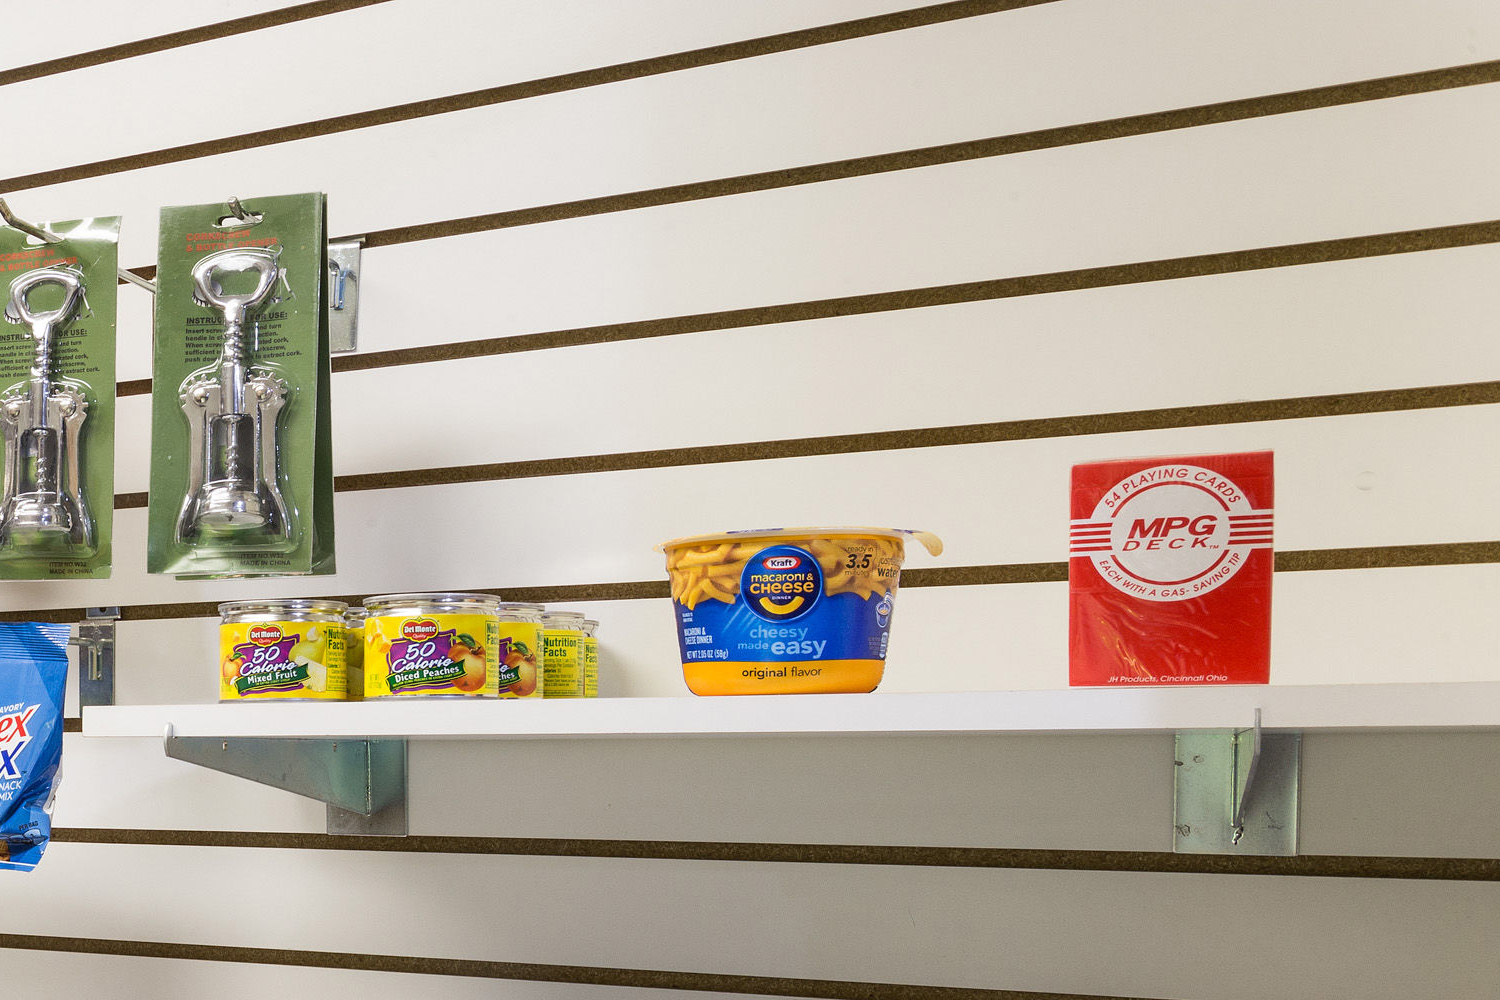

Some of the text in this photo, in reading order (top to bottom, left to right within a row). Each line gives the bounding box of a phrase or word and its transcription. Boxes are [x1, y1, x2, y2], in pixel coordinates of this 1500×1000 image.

[186, 229, 251, 242] CORKSCREW
[186, 237, 278, 252] & BOTTLE OPENER
[0, 249, 55, 262] CORKSCREW
[1105, 468, 1241, 508] 54 PLAYING CARDS
[1128, 515, 1218, 539] MPG
[1122, 536, 1211, 551] DECK
[770, 559, 793, 568] Kraft
[845, 553, 873, 569] 3.5
[750, 573, 814, 583] macaroni &
[261, 630, 281, 638] Monte
[404, 625, 437, 634] Del Monte
[750, 624, 808, 641] cheesy
[543, 637, 577, 648] Nutrition
[737, 638, 827, 659] made easy
[252, 646, 280, 664] 50
[405, 641, 436, 660] 50
[543, 647, 567, 657] Facts
[239, 660, 298, 677] Calorie
[390, 655, 453, 674] Calorie
[247, 673, 272, 685] Mixed
[275, 670, 298, 680] Fruit
[394, 666, 460, 684] Diced Peaches
[741, 666, 822, 680] original flavor
[1119, 674, 1159, 683] Products,
[1160, 674, 1205, 683] Cincinnati
[1207, 674, 1228, 682] Ohio
